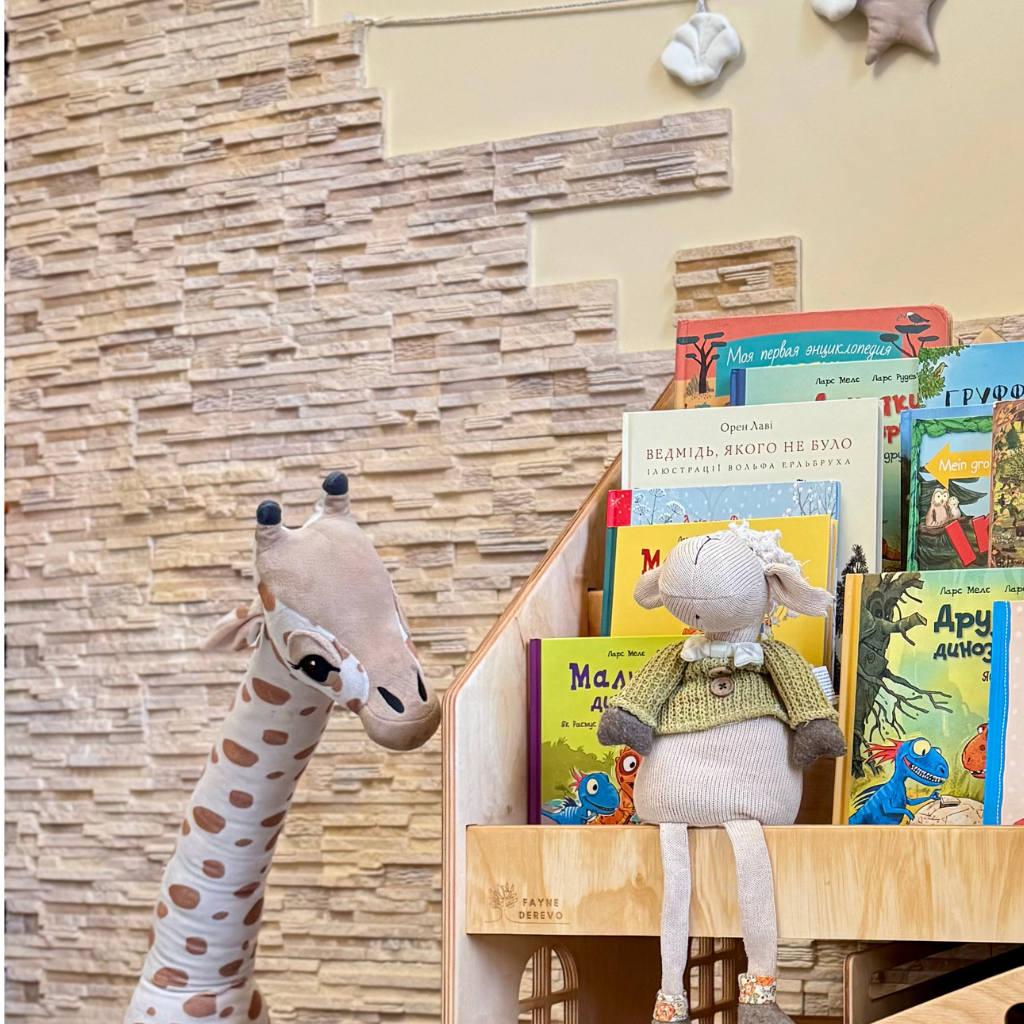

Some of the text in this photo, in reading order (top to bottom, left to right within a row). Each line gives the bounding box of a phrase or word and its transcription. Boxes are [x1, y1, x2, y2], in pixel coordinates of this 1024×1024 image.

[726, 339, 893, 367] Моя первая энциклопедия
[815, 377, 836, 387] Ларс
[871, 374, 893, 384] Ларс
[720, 420, 774, 435] Орен Лаві
[646, 437, 853, 462] ВЕДМІДЬ, ЯКОГО НЕ БУЛО
[647, 463, 722, 476] ІЛЮСТРАЦІЇ
[728, 462, 776, 472] ВОЛЬФА
[938, 458, 967, 472] Mein
[940, 587, 963, 597] Ларс
[933, 603, 992, 639] Дру
[607, 650, 625, 660] Ларс
[569, 662, 633, 691] Мал
[518, 898, 563, 920] FAYNE DEREVO
